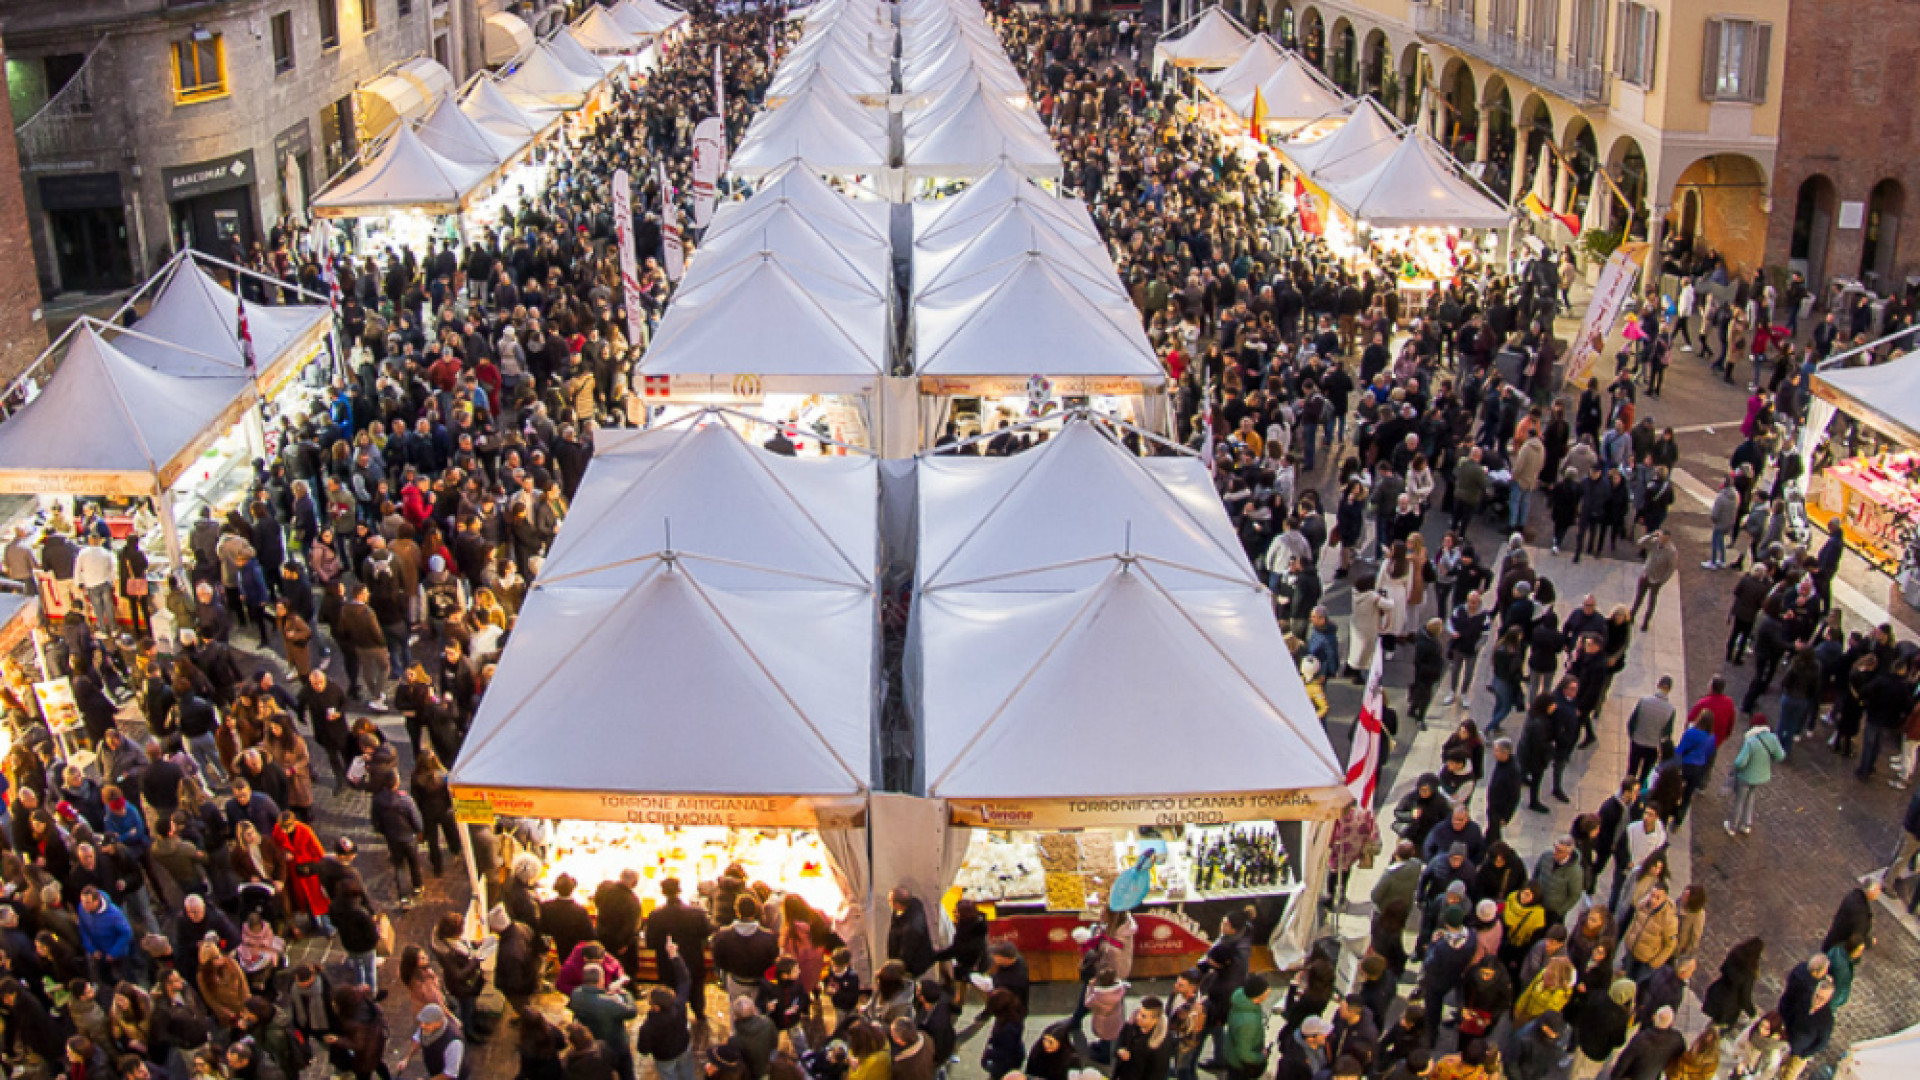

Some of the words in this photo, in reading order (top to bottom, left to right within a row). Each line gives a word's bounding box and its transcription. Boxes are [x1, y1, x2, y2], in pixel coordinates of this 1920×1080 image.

[172, 165, 228, 189] BANCOMAT
[600, 795, 673, 810] TORRONE
[677, 797, 777, 812] ARTIGIANALE
[1068, 798, 1176, 812] TORRONIFICIO
[1178, 795, 1245, 810] LICANIAS
[1250, 793, 1312, 808] TONARA
[627, 810, 642, 823] DI
[648, 811, 723, 825] CREMONA
[1155, 811, 1224, 825] (NUORO)
